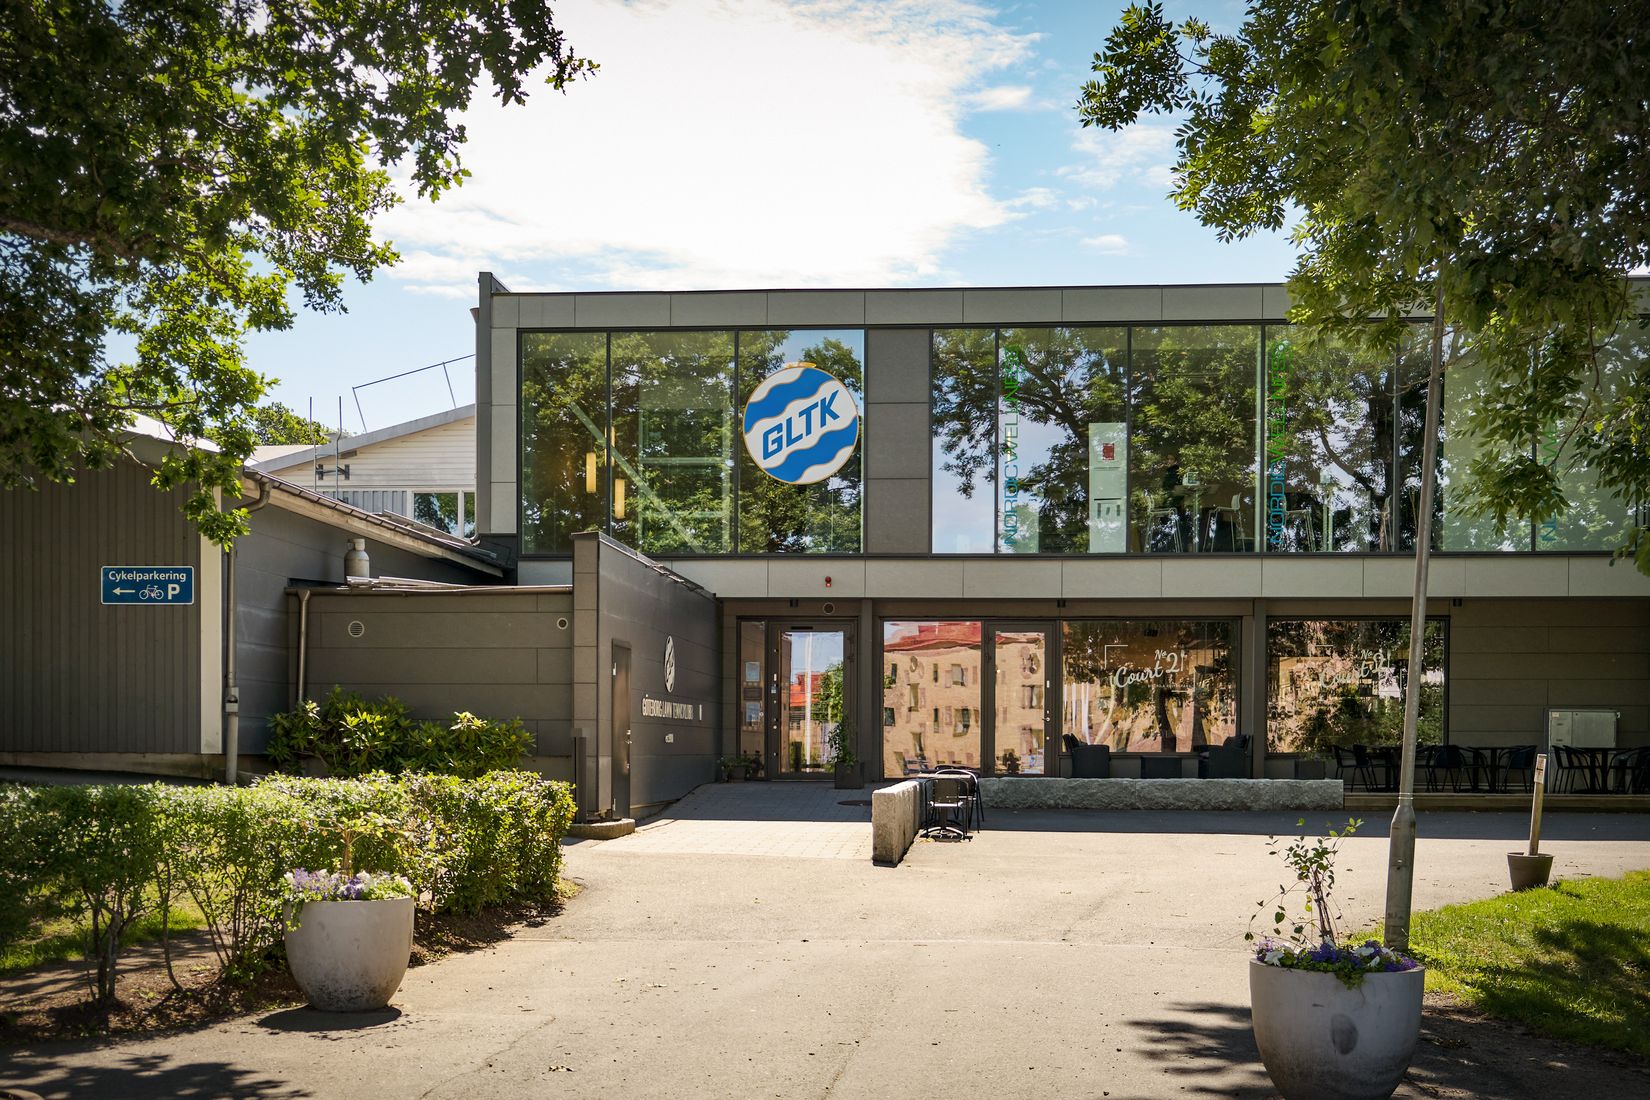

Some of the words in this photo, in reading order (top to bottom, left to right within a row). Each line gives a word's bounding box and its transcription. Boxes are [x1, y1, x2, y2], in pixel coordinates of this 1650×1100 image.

[762, 389, 840, 460] GLTK
[108, 570, 187, 583] Cykelparkering
[167, 583, 180, 600] P
[1115, 660, 1164, 688] Court
[1165, 652, 1180, 673] 2
